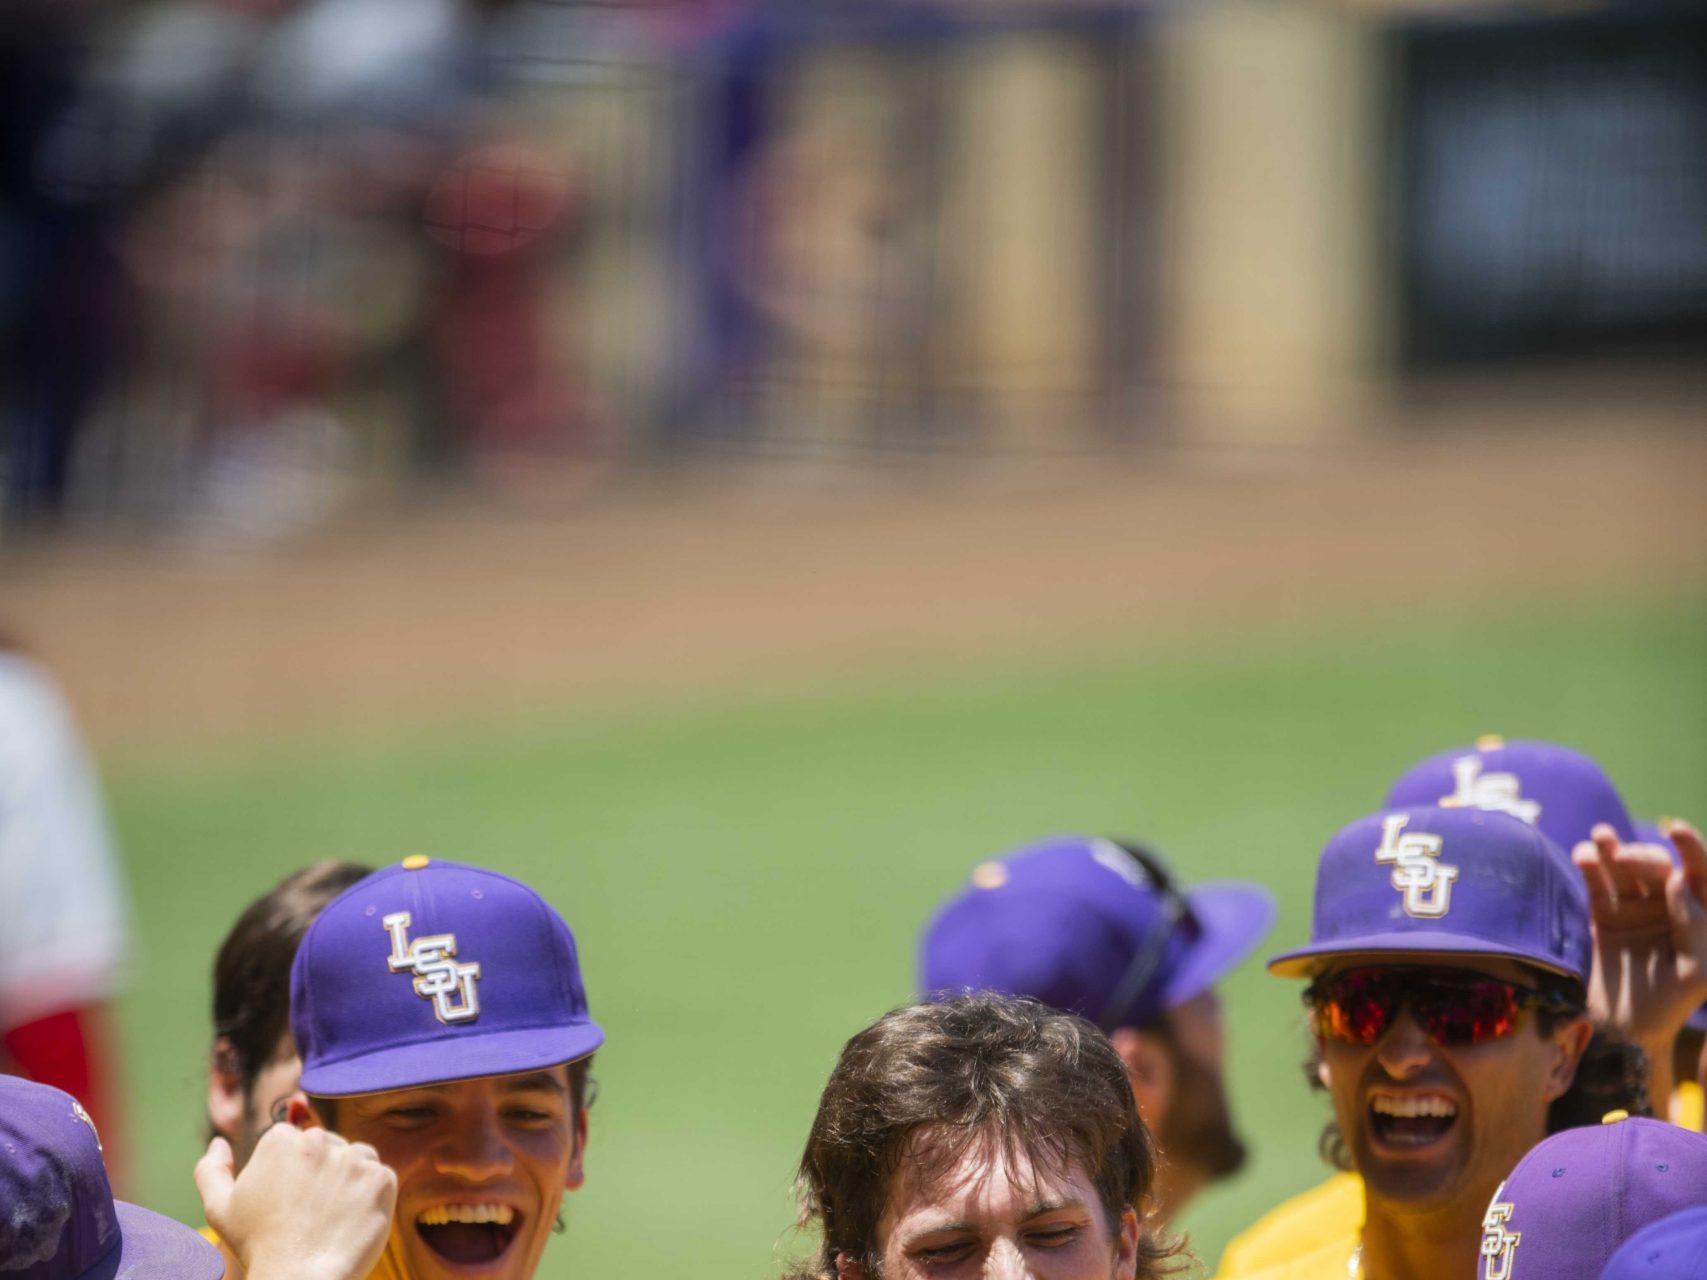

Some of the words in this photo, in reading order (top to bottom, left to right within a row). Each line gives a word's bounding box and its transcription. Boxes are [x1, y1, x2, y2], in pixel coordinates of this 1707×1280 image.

[1438, 754, 1542, 825] LS
[1375, 813, 1459, 919] LSU
[383, 911, 481, 1025] LSU
